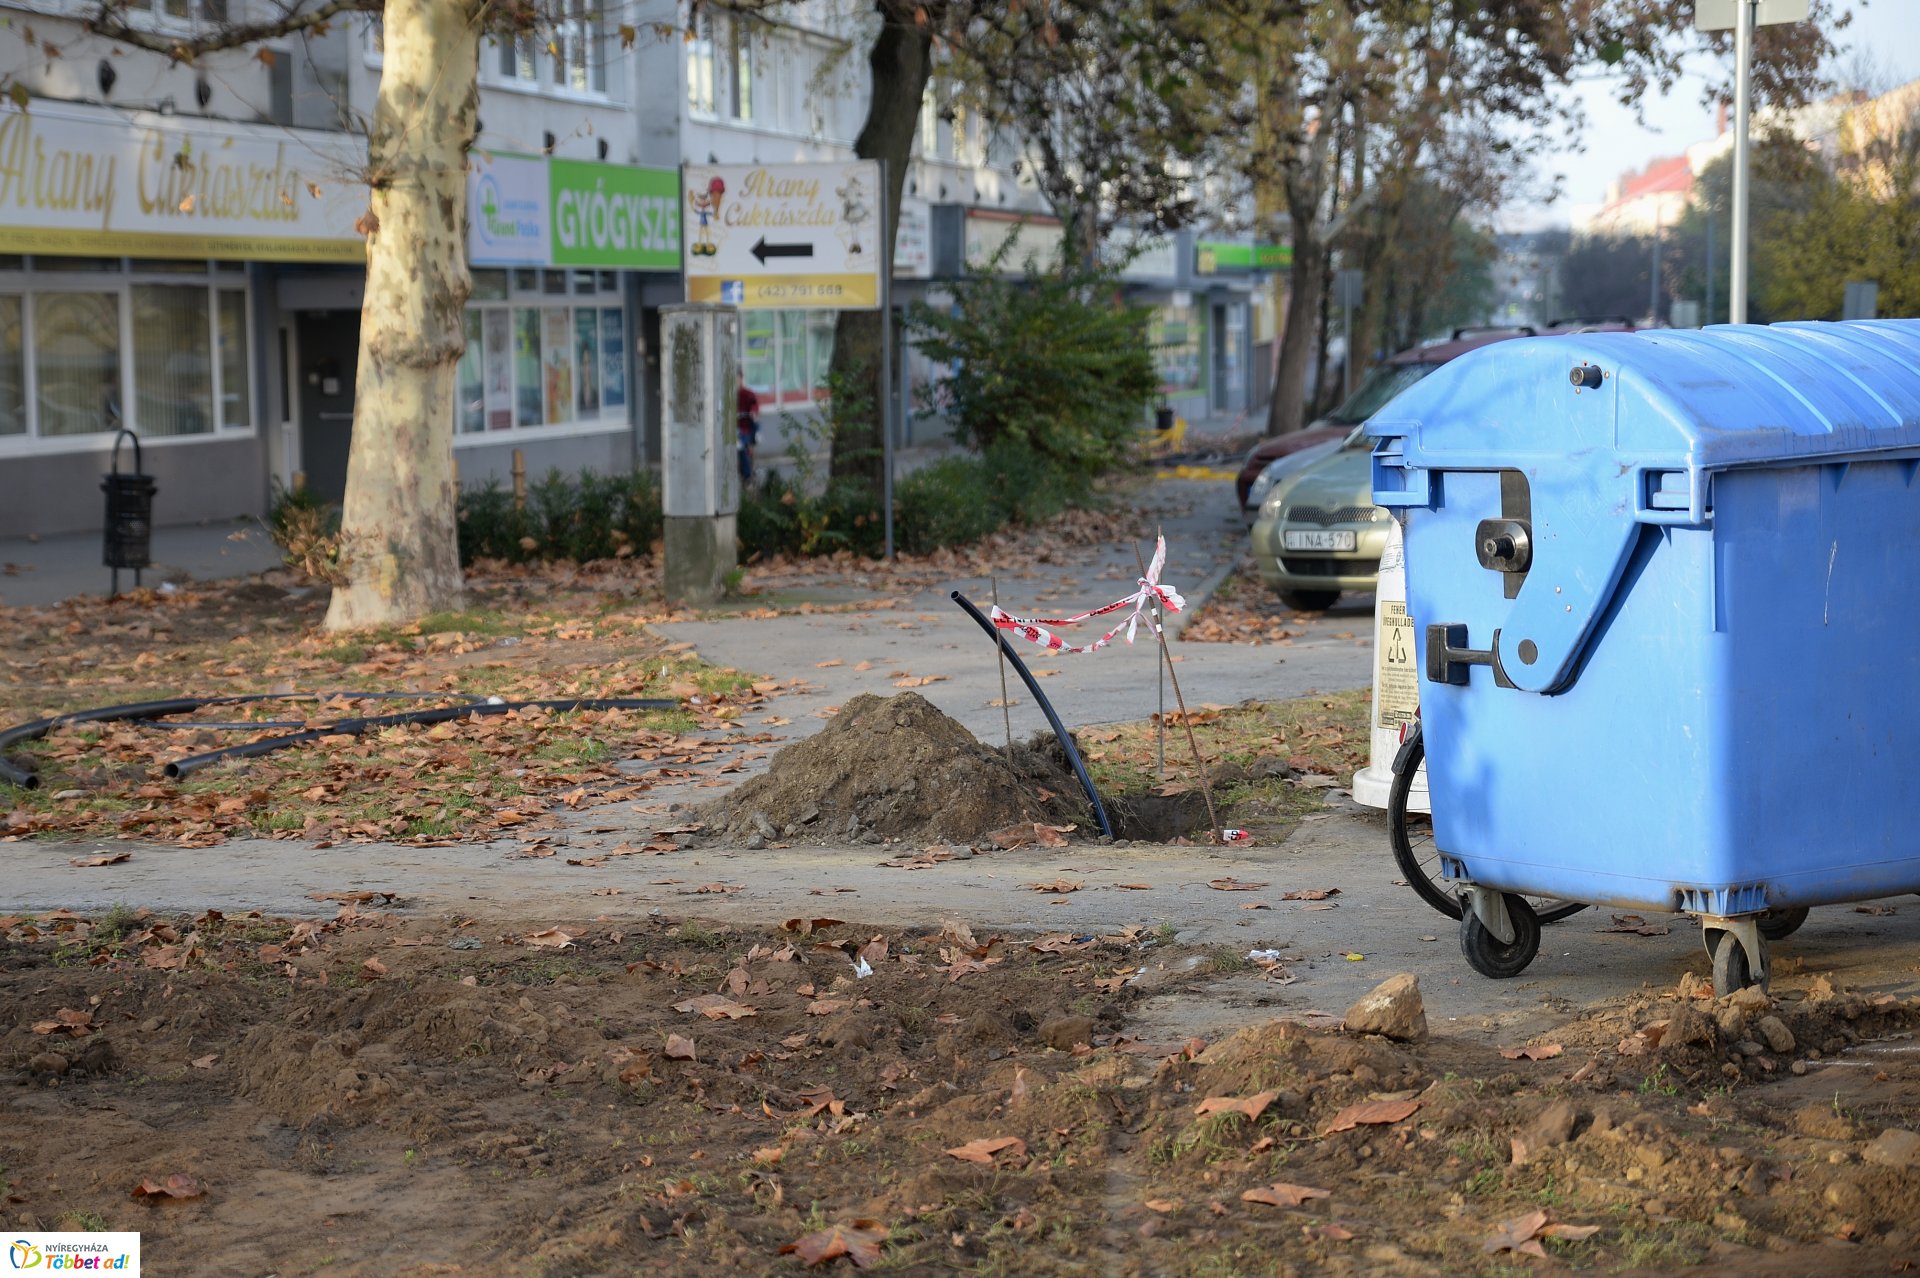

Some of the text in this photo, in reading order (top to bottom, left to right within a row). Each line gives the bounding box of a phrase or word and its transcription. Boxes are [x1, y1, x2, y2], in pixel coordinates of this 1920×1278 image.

[0, 112, 117, 231] Arany
[739, 168, 821, 199] Arany
[724, 202, 836, 228] Cukrászda
